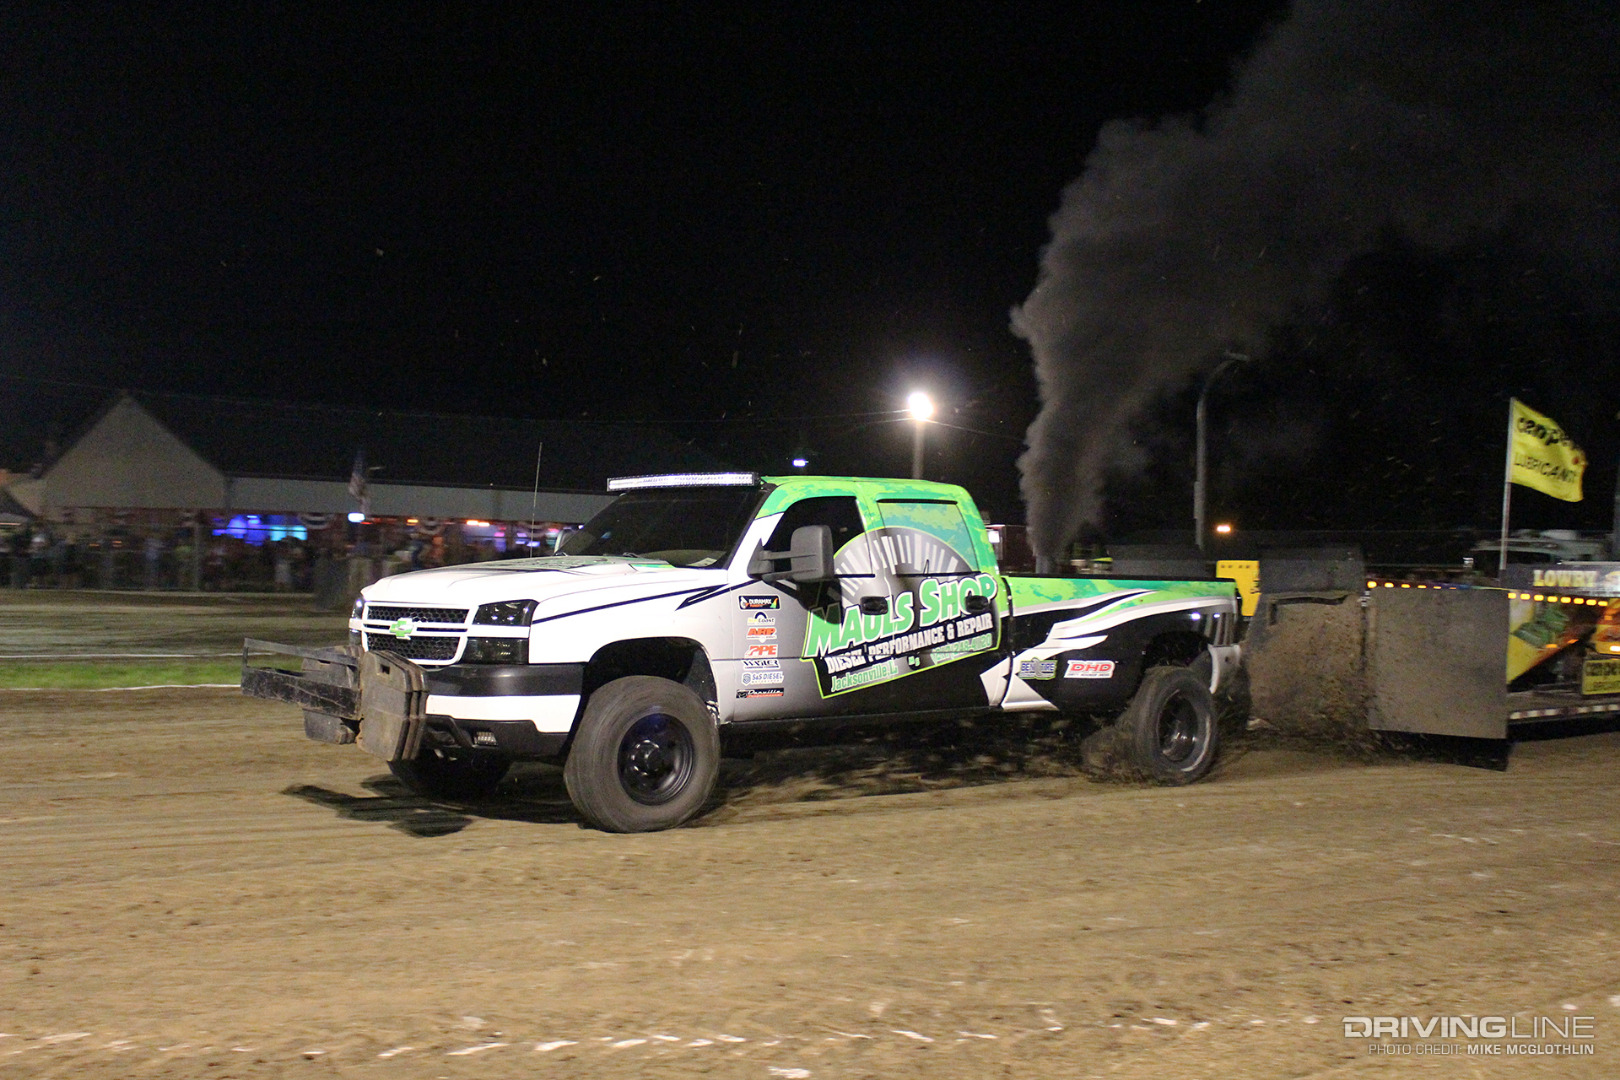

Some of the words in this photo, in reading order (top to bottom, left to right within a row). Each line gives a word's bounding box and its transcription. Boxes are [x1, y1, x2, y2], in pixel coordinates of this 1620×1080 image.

[804, 591, 914, 657] MAULS
[918, 572, 997, 627] SHOP
[748, 628, 776, 636] ARP
[823, 649, 866, 674] DIESEL
[868, 626, 945, 662] PERFORMANCE
[946, 623, 955, 641] &
[956, 613, 994, 638] REPAIR
[749, 645, 777, 656] PPE
[1071, 664, 1111, 672] DHD
[763, 672, 782, 680] DIESEL
